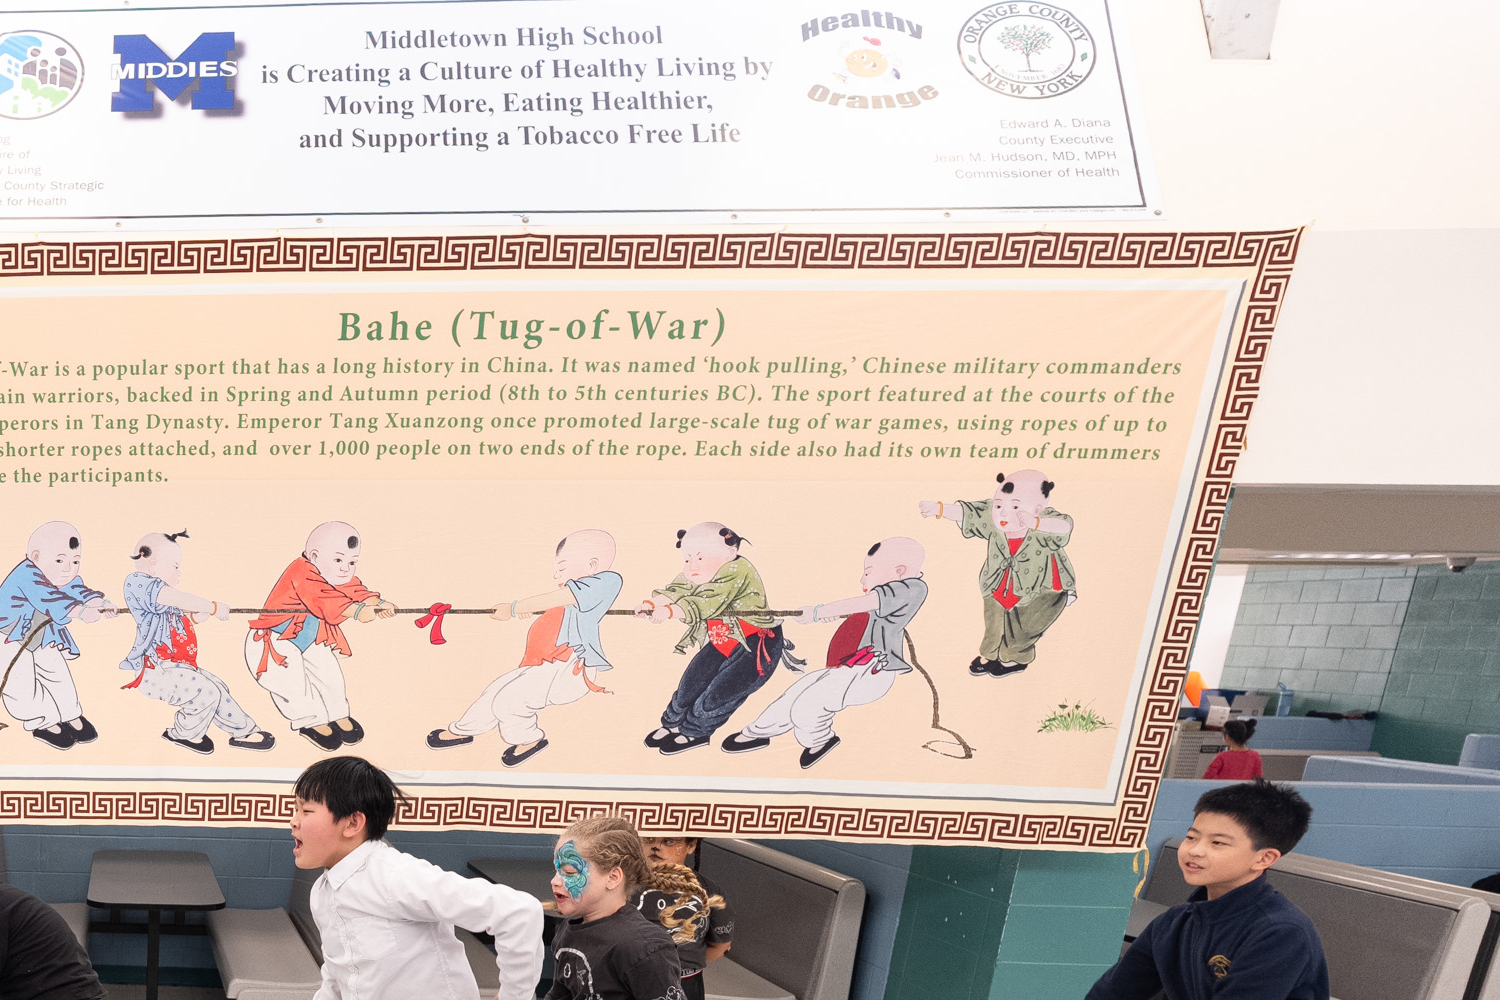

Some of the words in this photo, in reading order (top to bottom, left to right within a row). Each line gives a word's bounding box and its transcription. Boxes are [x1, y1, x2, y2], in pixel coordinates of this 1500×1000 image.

[800, 8, 924, 43] Healthy
[964, 4, 1020, 44] ORANGE
[1028, 4, 1088, 43] COUNTY
[365, 30, 507, 49] Middletown
[517, 27, 574, 51] High
[583, 25, 662, 45] School
[110, 59, 238, 81] MIDDIES
[262, 65, 278, 83] is
[287, 63, 390, 87] Creating
[399, 68, 411, 81] a
[420, 61, 512, 80] Culture
[521, 60, 545, 78] of
[552, 58, 647, 82] Healthy
[657, 57, 736, 81] Living
[744, 56, 772, 80] by
[1000, 69, 1048, 81] NOVEMBER
[981, 71, 1027, 96] NEW
[1035, 70, 1083, 96] YORK
[324, 95, 414, 119] Moving
[423, 94, 494, 114] More,
[504, 92, 583, 116] Eating
[592, 90, 713, 111] Healthier,
[806, 81, 940, 110] Orange
[1000, 119, 1049, 129] Edward
[1054, 119, 1066, 128] A.
[1071, 118, 1111, 128] Diana
[300, 129, 342, 148] and
[352, 127, 489, 153] Supporting
[497, 132, 509, 145] a
[517, 126, 618, 145] Tobacco
[628, 124, 682, 143] Free
[692, 123, 740, 143] Life
[999, 136, 1044, 147] County
[1050, 135, 1113, 144] Executive
[18, 150, 30, 159] of
[934, 154, 964, 163] Jean
[969, 152, 985, 162] M.
[1085, 151, 1116, 160] MPH
[7, 166, 42, 176] Living
[955, 169, 1052, 179] Commissioner
[1057, 168, 1070, 177] of
[1075, 167, 1120, 177] Health
[4, 181, 44, 192] County
[50, 181, 104, 192] Strategic
[7, 197, 23, 206] for
[28, 197, 67, 206] Health
[337, 310, 432, 341] Bahe
[452, 307, 725, 350] (Tug-of-War)
[55, 361, 69, 376] is
[76, 365, 85, 376] a
[93, 359, 168, 381] popular
[175, 361, 225, 380] sport
[232, 358, 270, 374] that
[278, 358, 309, 374] has
[316, 363, 325, 374] a
[333, 357, 377, 379] long
[383, 357, 454, 378] history
[461, 357, 479, 373] in
[487, 356, 553, 373] China.
[561, 357, 578, 373] It
[585, 361, 620, 373] was
[628, 356, 695, 373] named
[704, 356, 760, 373] ‘hook
[766, 356, 856, 379] pulling,’
[863, 356, 946, 374] Chinese
[953, 357, 1040, 379] military
[1046, 357, 1181, 375] commanders
[32, 388, 119, 405] warriors,
[127, 386, 193, 403] backed
[201, 387, 218, 402] in
[226, 386, 291, 407] Spring
[298, 385, 332, 401] and
[339, 385, 418, 401] Autumn
[426, 384, 491, 406] period
[500, 384, 539, 404] (8th
[548, 386, 567, 401] to
[575, 384, 606, 401] 5th
[615, 385, 708, 401] centuries
[716, 384, 762, 405] BC).
[772, 384, 809, 401] The
[817, 387, 871, 406] sport
[878, 385, 966, 402] featured
[973, 388, 993, 402] at
[1001, 385, 1033, 402] the
[1040, 388, 1106, 403] courts
[1114, 386, 1139, 403] of
[1142, 386, 1174, 404] the
[66, 415, 83, 430] in
[91, 414, 139, 434] Tang
[146, 414, 229, 434] Dynasty.
[237, 413, 322, 433] Emperor
[329, 413, 378, 433] Tang
[385, 413, 484, 433] Xuanzong
[491, 417, 536, 428] once
[543, 412, 642, 433] promoted
[649, 412, 760, 434] large-scale
[768, 415, 800, 434] tug
[807, 412, 831, 429] of
[835, 418, 872, 429] war
[877, 418, 948, 435] games,
[957, 414, 1014, 436] using
[1020, 419, 1077, 436] ropes
[1085, 414, 1110, 431] of
[1114, 420, 1139, 437] up
[1147, 417, 1167, 432] to
[71, 445, 122, 461] ropes
[129, 440, 215, 458] attached,
[223, 440, 257, 456] and
[270, 445, 311, 455] over
[319, 440, 369, 458] 1,000
[376, 439, 441, 460] people
[448, 444, 470, 455] on
[479, 441, 513, 455] two
[520, 439, 565, 455] ends
[572, 439, 595, 455] of
[599, 439, 629, 456] the
[636, 445, 686, 461] rope.
[695, 440, 741, 456] Each
[749, 440, 790, 456] side
[797, 440, 837, 457] also
[844, 441, 882, 457] had
[888, 441, 913, 457] its
[920, 446, 961, 458] own
[970, 444, 1018, 458] team
[1026, 441, 1048, 460] of
[1052, 443, 1161, 461] drummers
[13, 467, 42, 483] the
[48, 467, 168, 487] participants.
